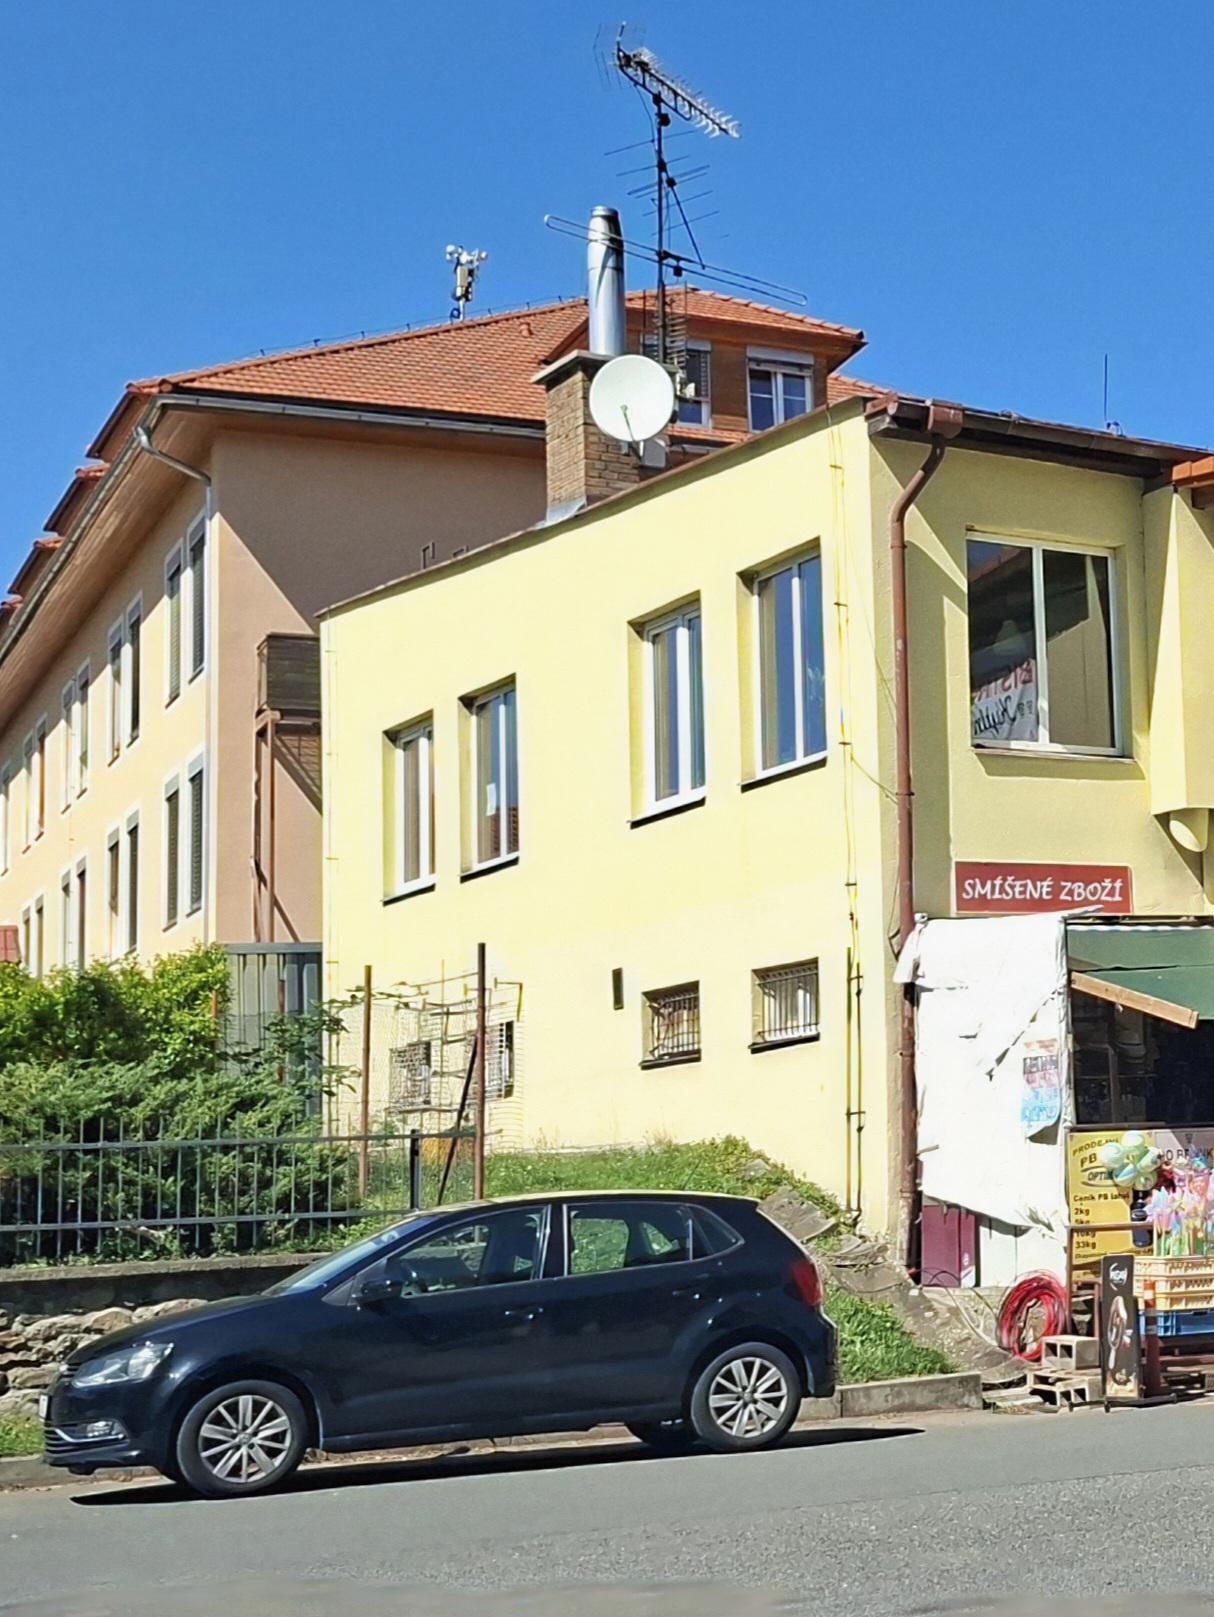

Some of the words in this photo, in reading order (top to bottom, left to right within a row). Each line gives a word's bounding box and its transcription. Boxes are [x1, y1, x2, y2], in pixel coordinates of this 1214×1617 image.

[961, 875, 1054, 901] SMÍŠENÉ
[1059, 878, 1124, 902] ZBOŽÍ
[1080, 1152, 1098, 1168] PB
